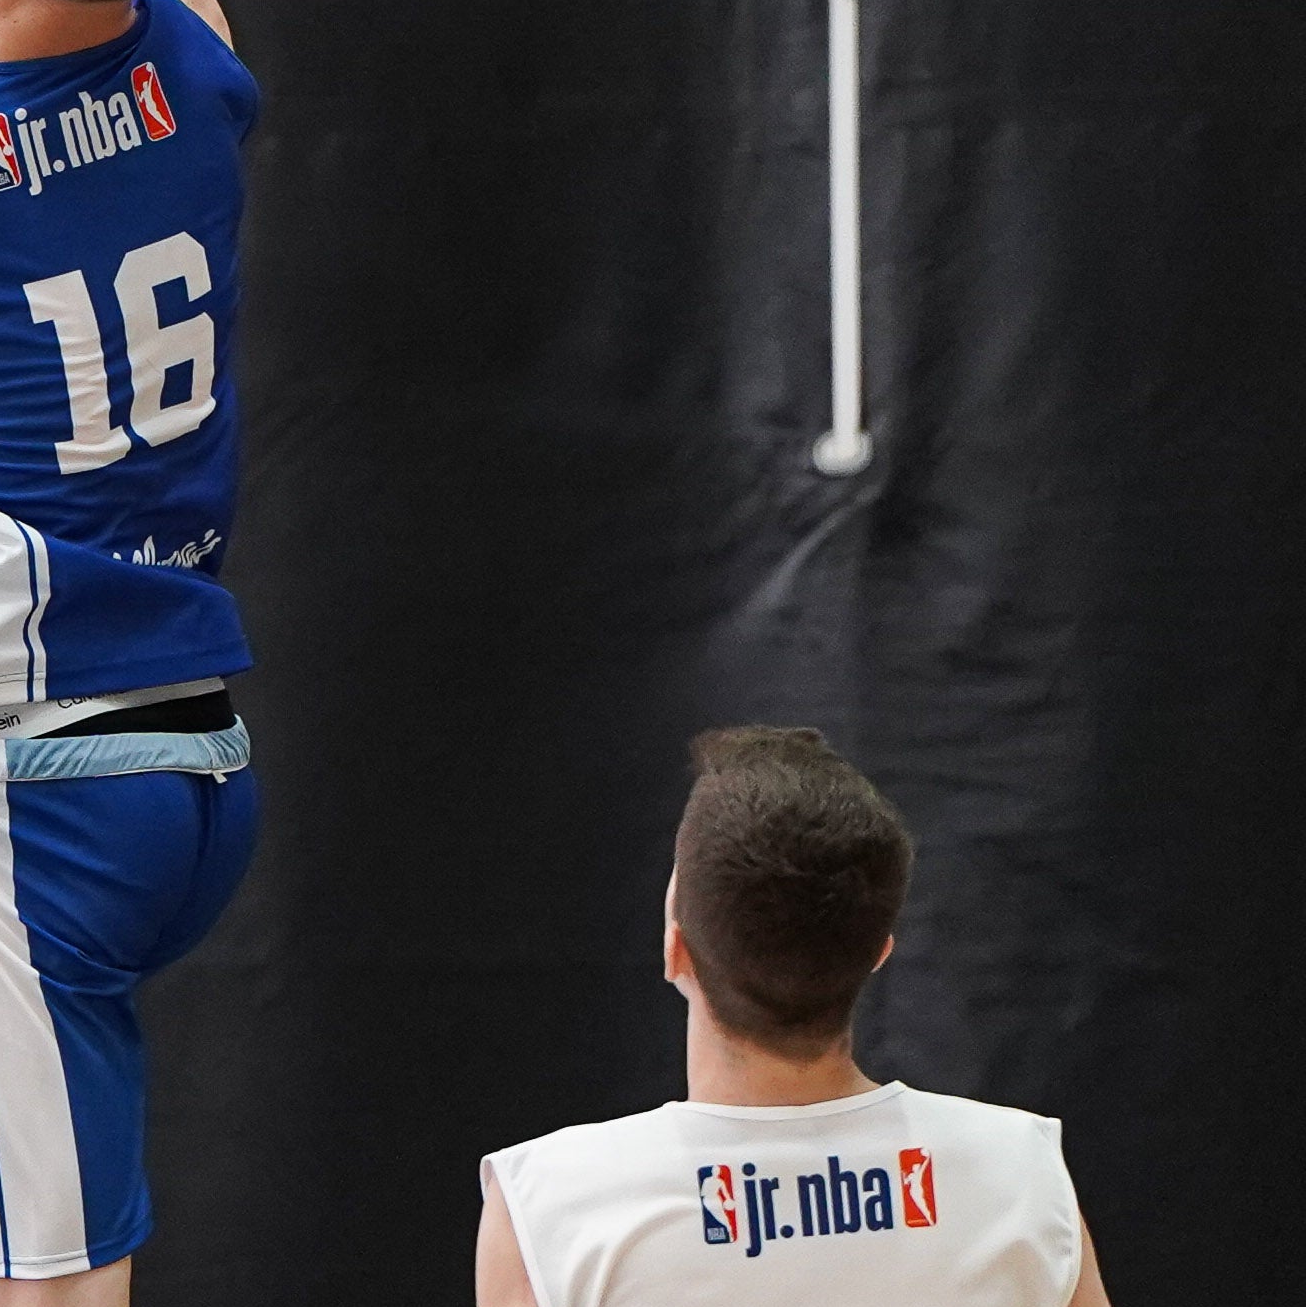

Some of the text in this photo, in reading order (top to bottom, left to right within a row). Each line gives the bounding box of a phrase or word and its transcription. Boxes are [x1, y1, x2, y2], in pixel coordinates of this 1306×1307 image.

[15, 91, 143, 196] jr.nba
[22, 231, 217, 475] 16
[741, 1156, 894, 1258] jr.nba
